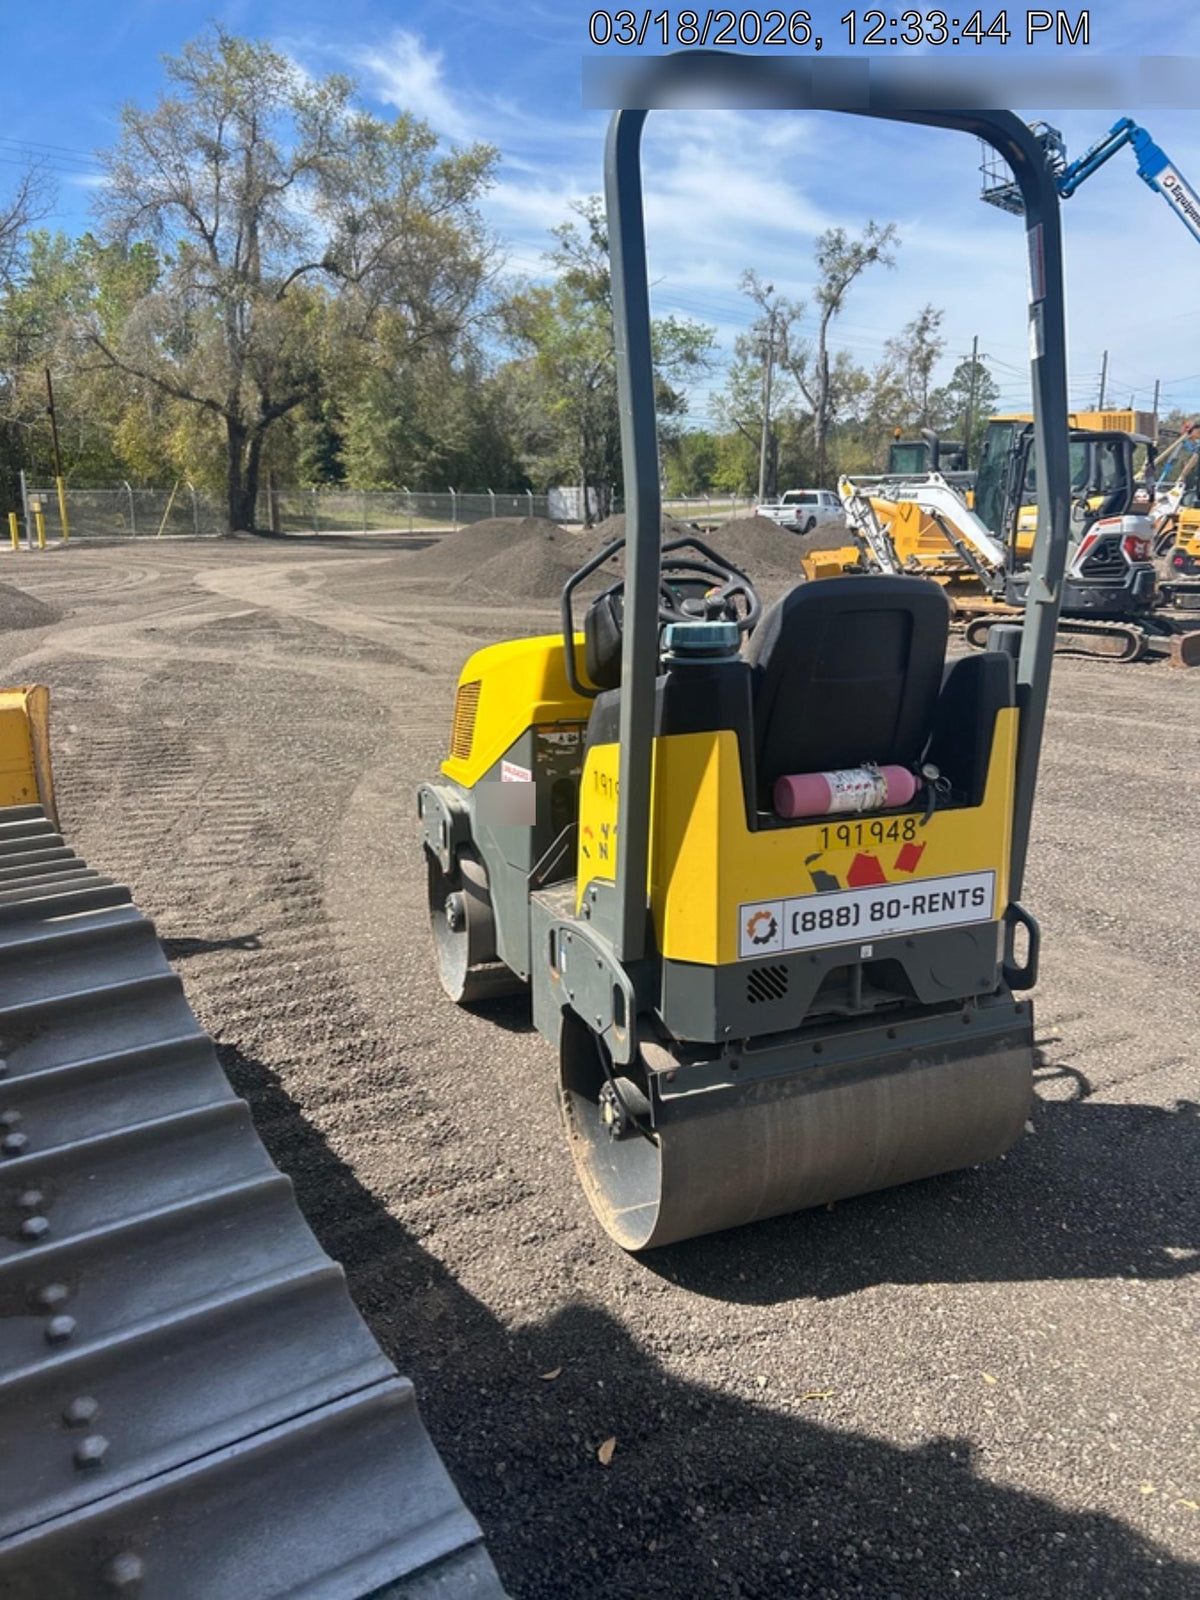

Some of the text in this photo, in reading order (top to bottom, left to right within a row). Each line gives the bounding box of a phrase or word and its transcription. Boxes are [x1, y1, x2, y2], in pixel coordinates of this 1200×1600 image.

[821, 818, 916, 849] 191948
[791, 887, 985, 935] (888) 80-RENTS
